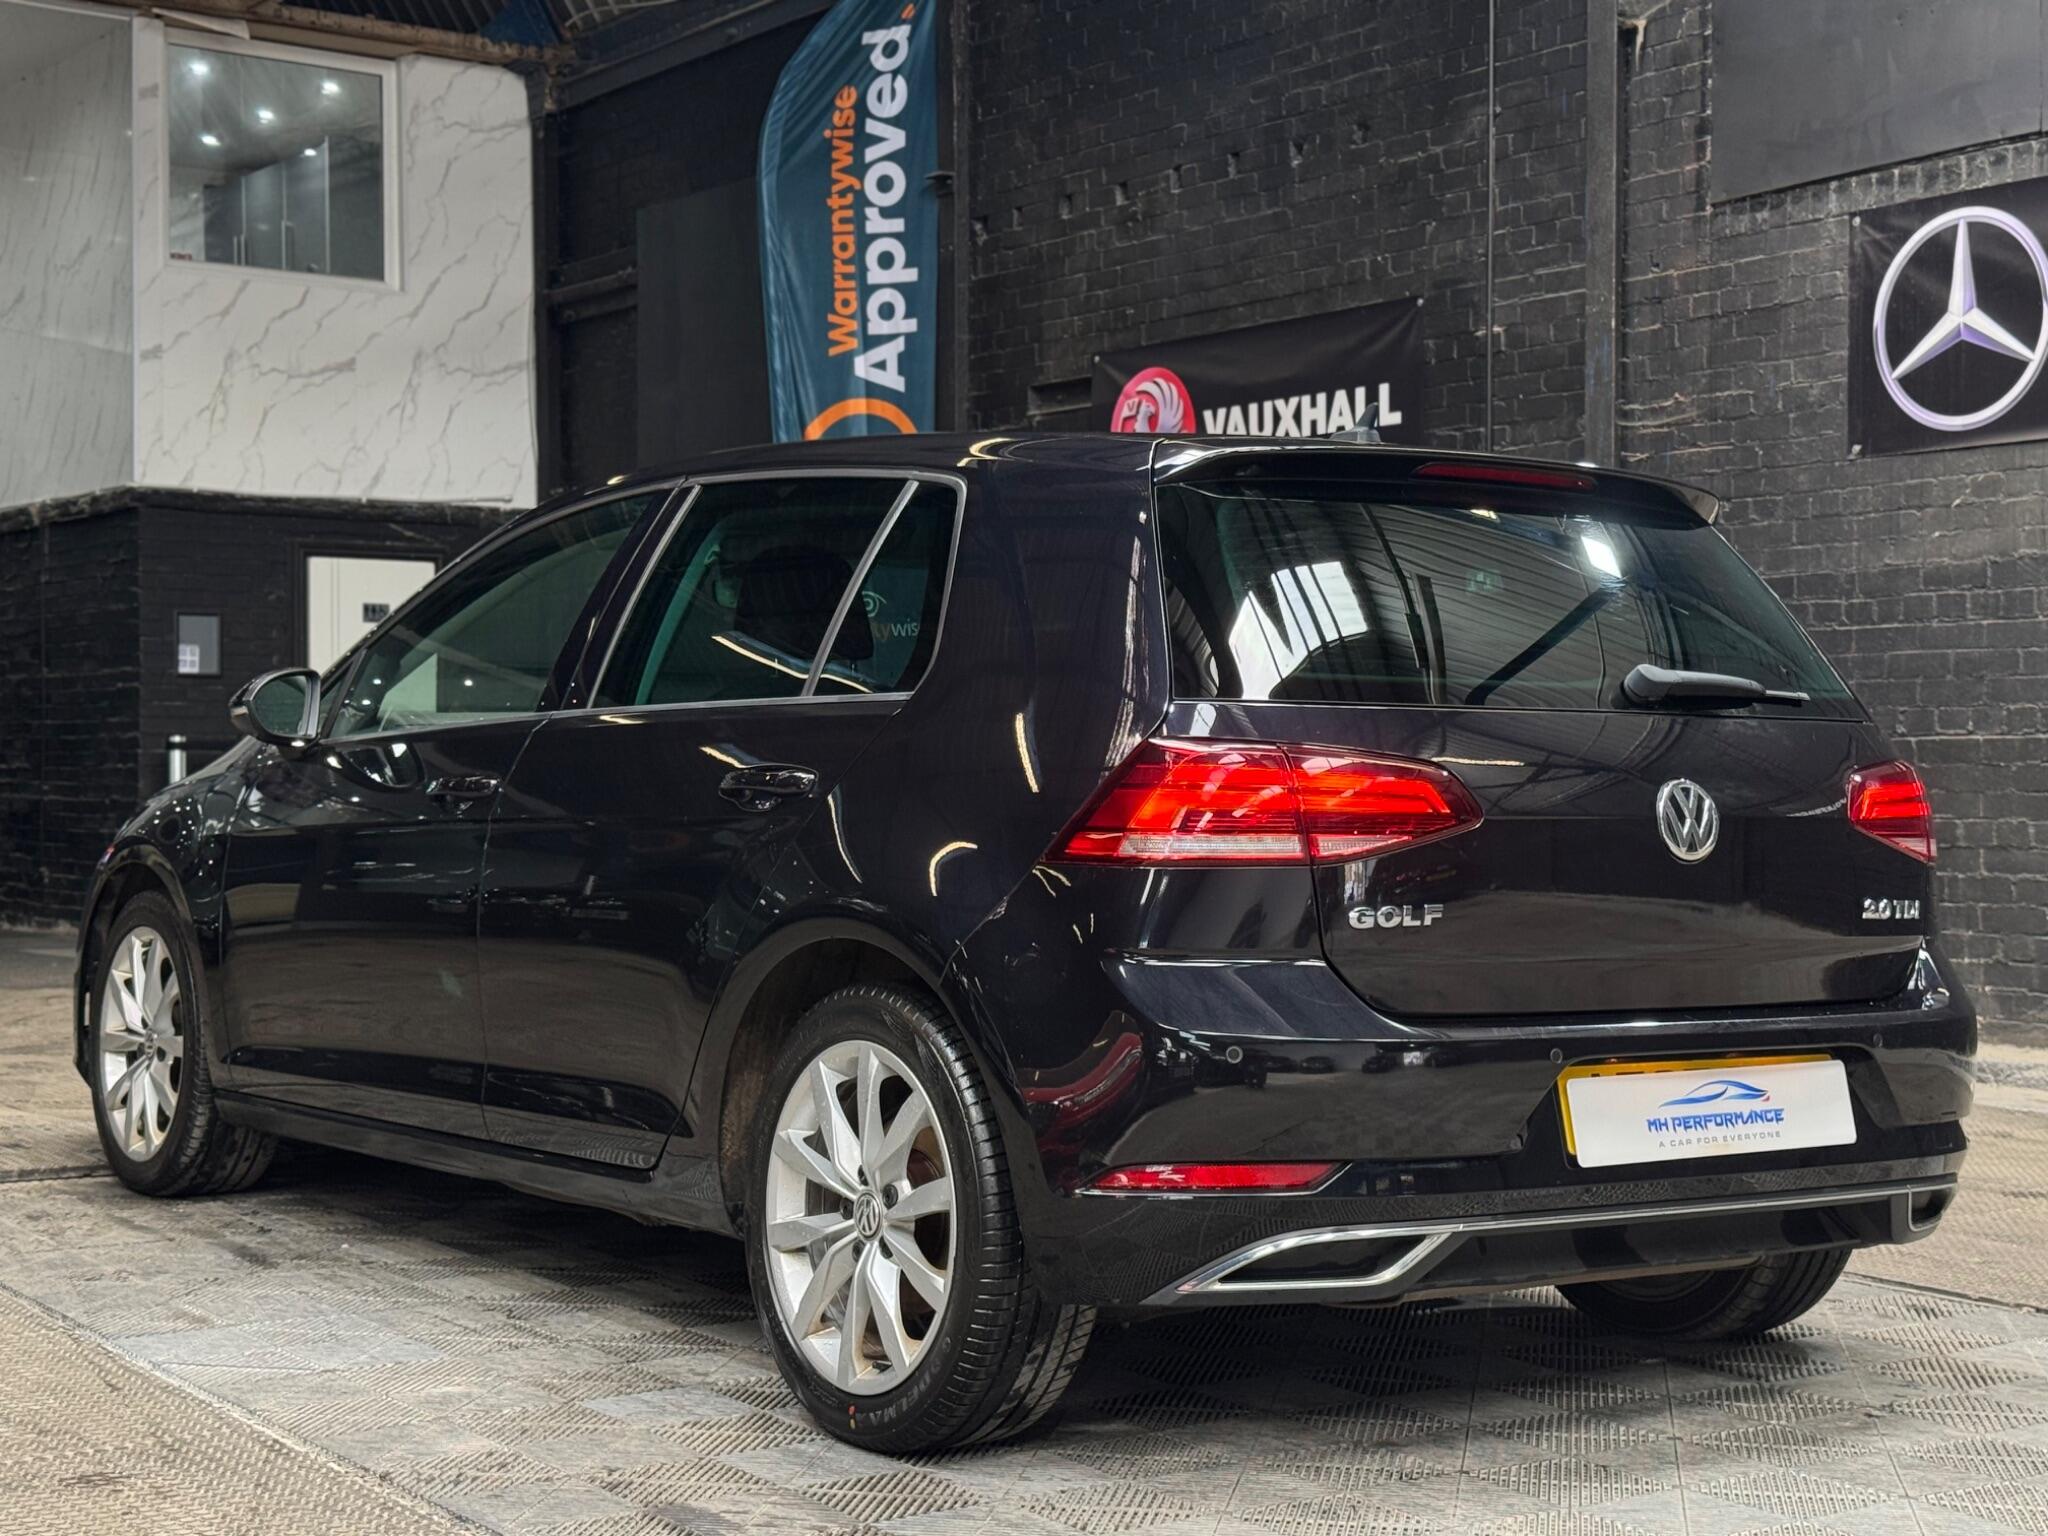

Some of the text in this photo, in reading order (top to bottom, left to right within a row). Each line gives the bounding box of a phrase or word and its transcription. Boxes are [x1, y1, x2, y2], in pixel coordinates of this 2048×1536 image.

[824, 85, 861, 357] Warrantywise
[1348, 903, 1444, 930] GOLF
[1646, 1107, 1786, 1134] MH PERFORMANCE
[1658, 1130, 1782, 1149] A CAR FOR EVERYONE
